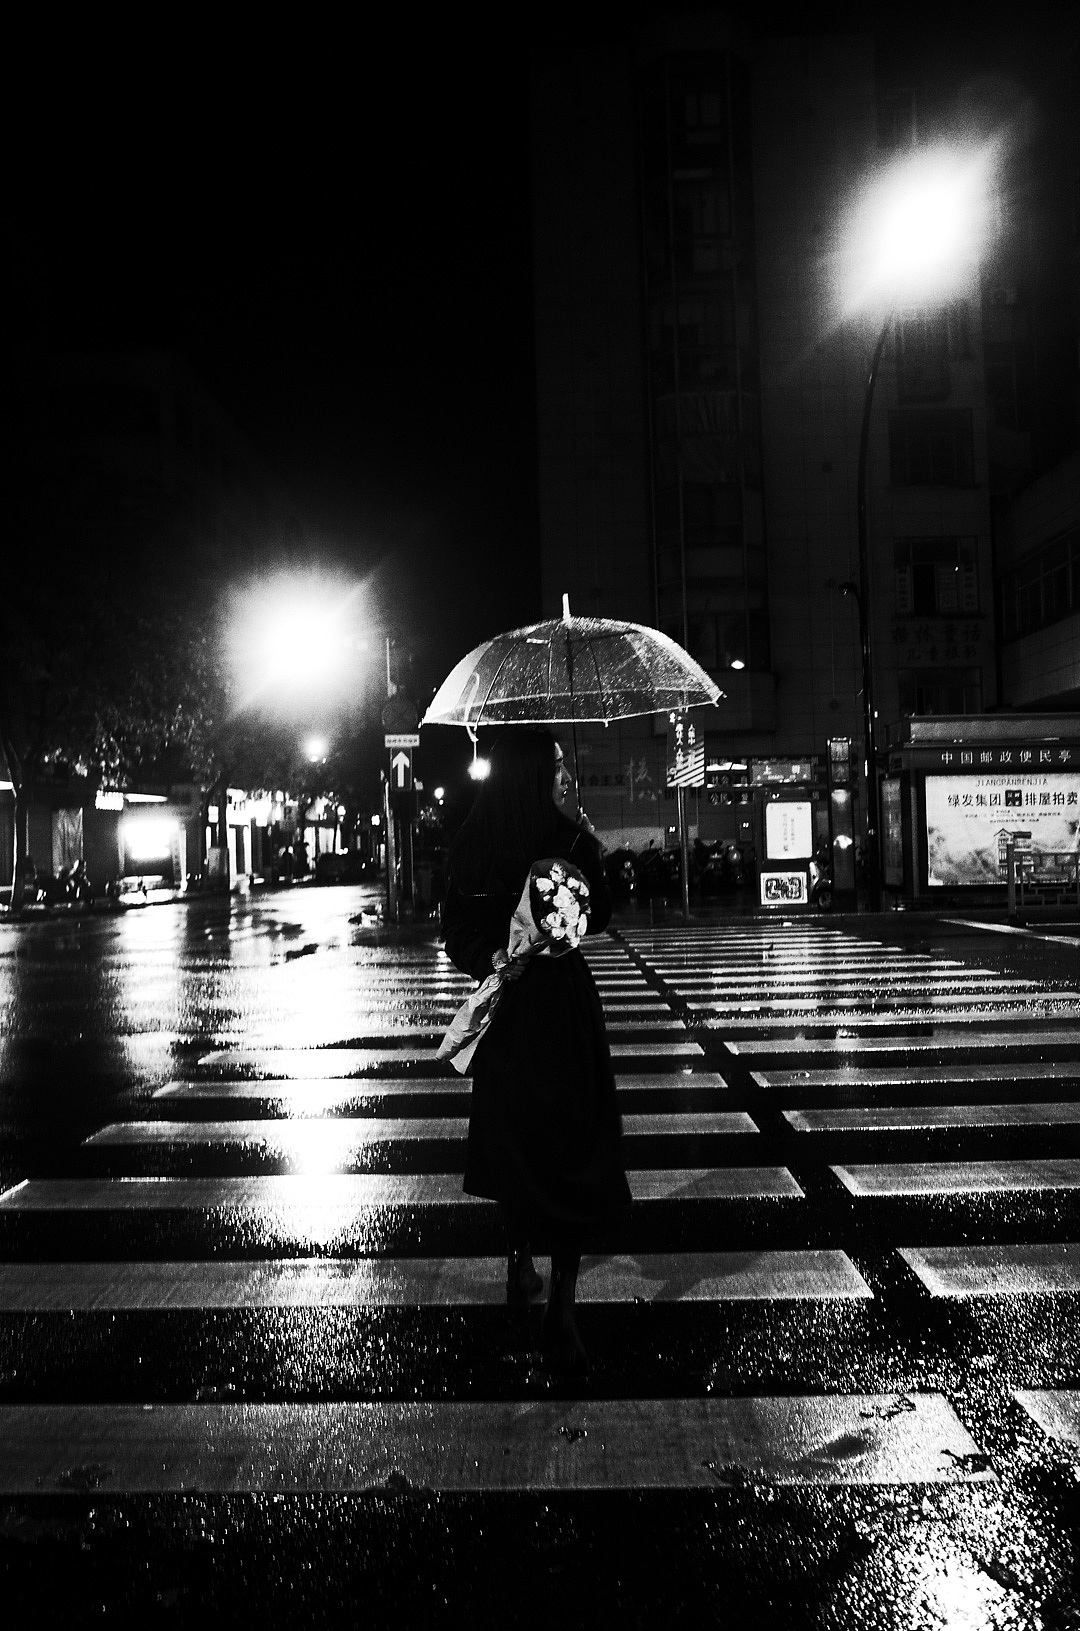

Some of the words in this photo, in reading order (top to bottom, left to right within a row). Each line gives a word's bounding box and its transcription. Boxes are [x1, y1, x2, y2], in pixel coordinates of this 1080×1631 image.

[891, 623, 982, 643] 格林童话
[941, 750, 1072, 765] 中国邮政便民亭
[947, 793, 1002, 808] 绿发集团
[1025, 791, 1079, 806] 排屋拍卖
